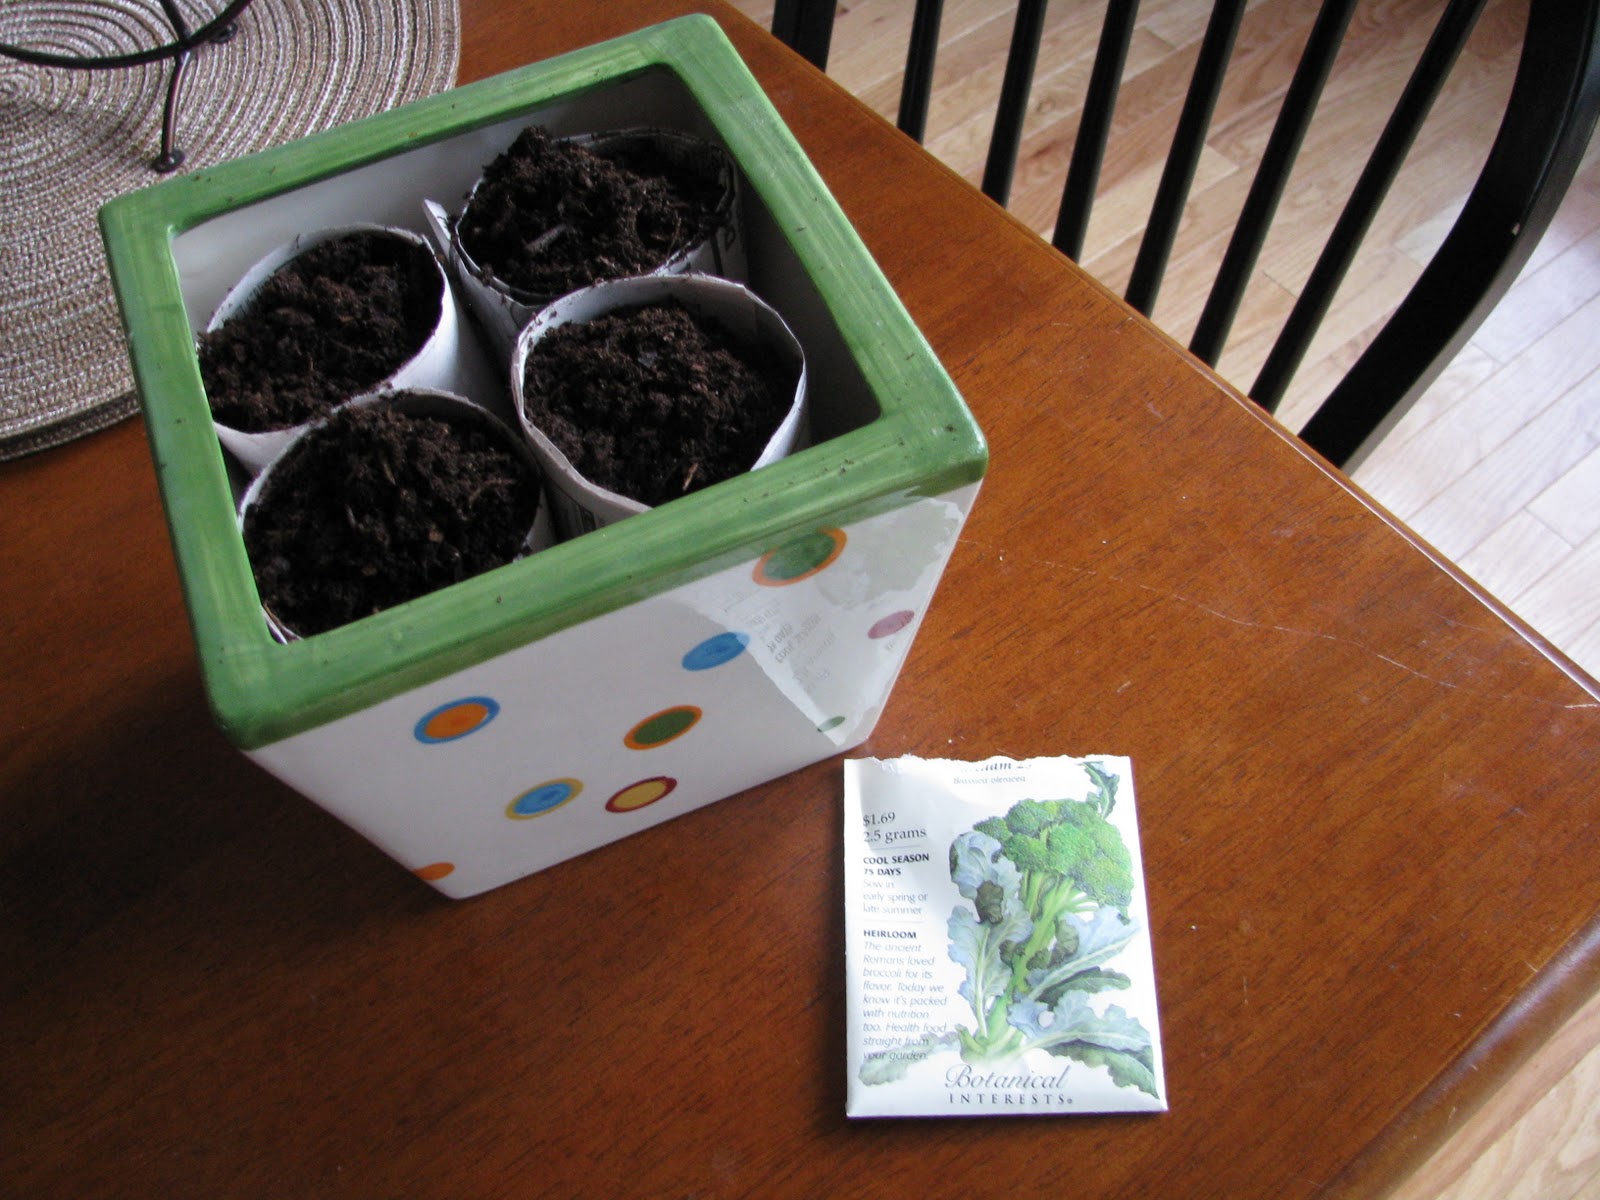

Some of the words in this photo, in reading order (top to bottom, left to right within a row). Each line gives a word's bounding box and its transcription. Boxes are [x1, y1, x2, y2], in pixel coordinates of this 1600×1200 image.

[862, 811, 896, 827] $1.69
[884, 828, 927, 845] grams
[863, 856, 889, 865] COOL
[891, 853, 930, 864] SEASON
[863, 868, 874, 876] 75
[877, 867, 902, 876] DAYS
[863, 879, 883, 889] Sow
[885, 879, 895, 889] in
[863, 891, 884, 902] early
[887, 892, 916, 905] spring
[917, 893, 928, 902] or
[863, 902, 879, 913] late
[882, 906, 922, 915] summer
[863, 929, 917, 939] HEIRLOOM
[864, 940, 882, 951] The
[884, 942, 922, 953] ancient
[863, 953, 904, 965] Romans
[907, 955, 936, 966] loved
[862, 966, 902, 978] broccoli
[905, 968, 918, 979] for
[921, 970, 933, 980] its
[897, 981, 927, 994] Today
[928, 984, 945, 993] we
[863, 993, 890, 1004] know
[909, 995, 948, 1007] packed
[862, 1008, 884, 1018] with
[887, 1009, 930, 1019] nutrition
[885, 1021, 920, 1033] Health
[923, 1021, 947, 1033] food
[862, 1036, 903, 1049] straight
[904, 1036, 930, 1046] from
[863, 1050, 887, 1062] your
[944, 1063, 1071, 1089] Botanical
